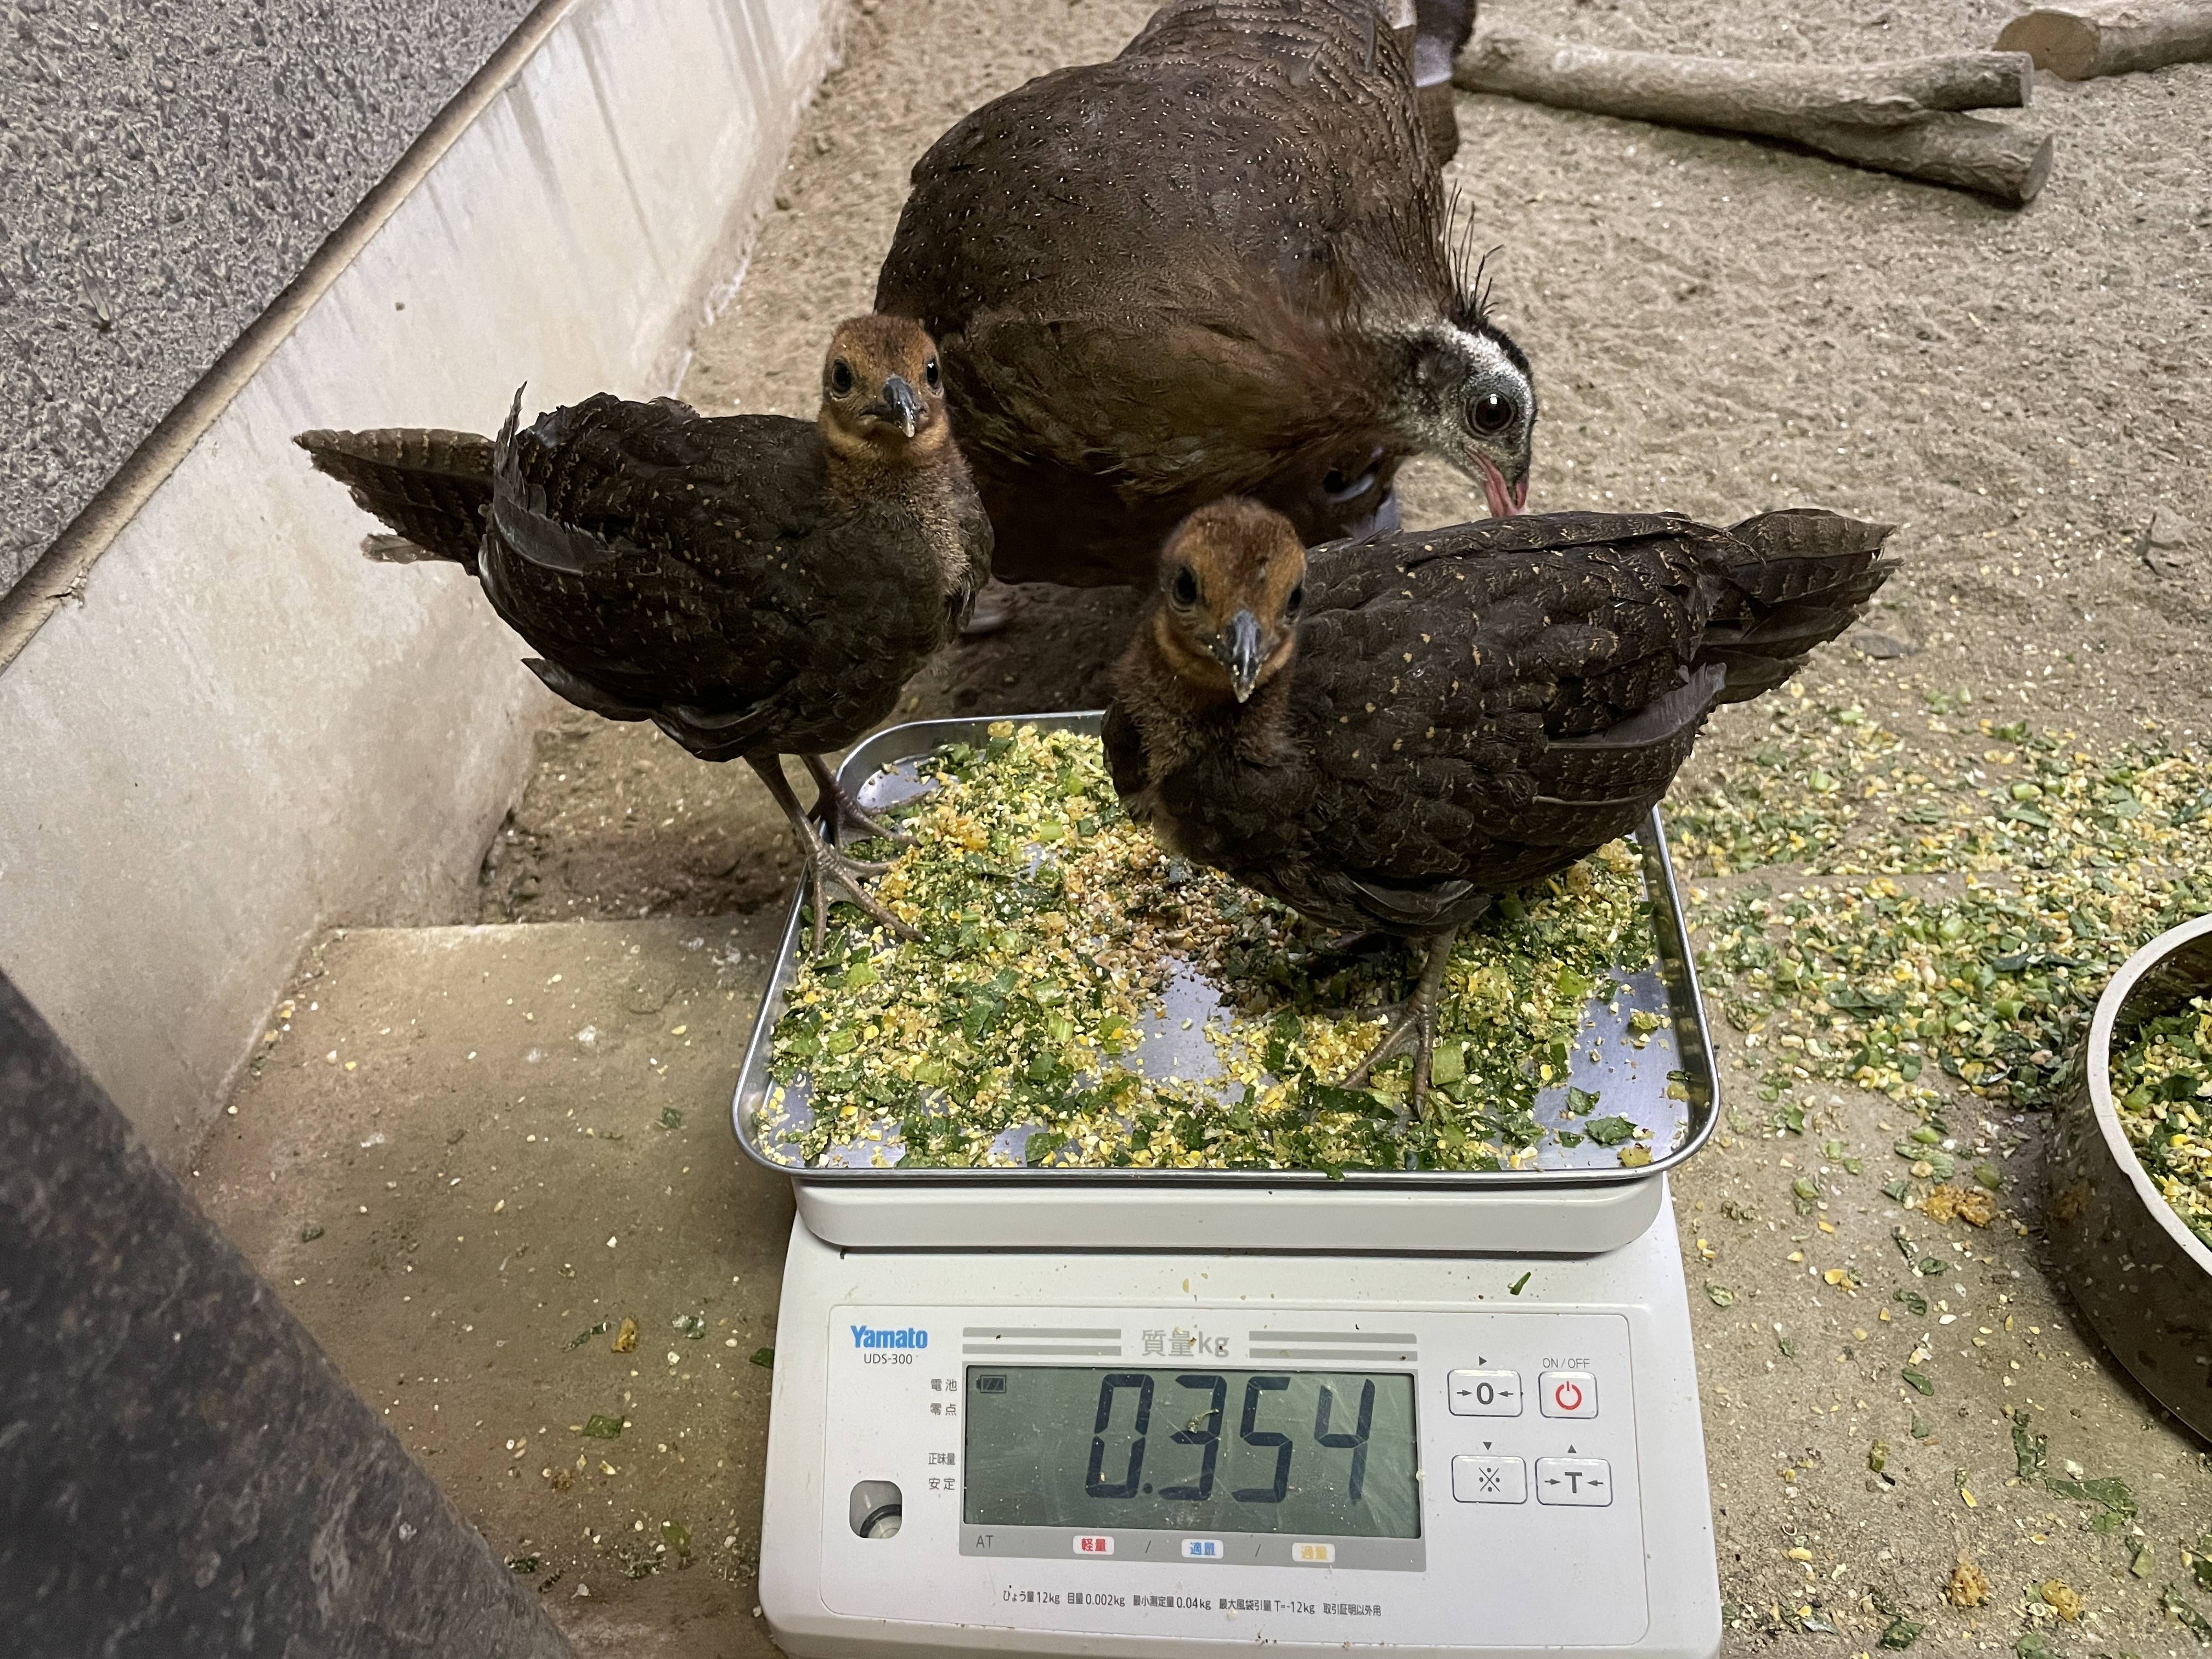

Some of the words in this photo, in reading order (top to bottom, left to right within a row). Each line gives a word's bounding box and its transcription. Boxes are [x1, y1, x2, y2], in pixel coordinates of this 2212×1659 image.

[850, 1325, 928, 1348] Yamato
[1141, 1329, 1229, 1357] 質量kg
[864, 1353, 912, 1365] UDS-300
[930, 1379, 957, 1392] 電池
[930, 1403, 957, 1416] 零点
[1085, 1374, 1375, 1504] 0.354
[928, 1453, 956, 1465] 正味量
[928, 1478, 955, 1491] 安定
[1565, 1471, 1583, 1493] T
[976, 1535, 994, 1548] AT
[1081, 1538, 1107, 1552] 軽量
